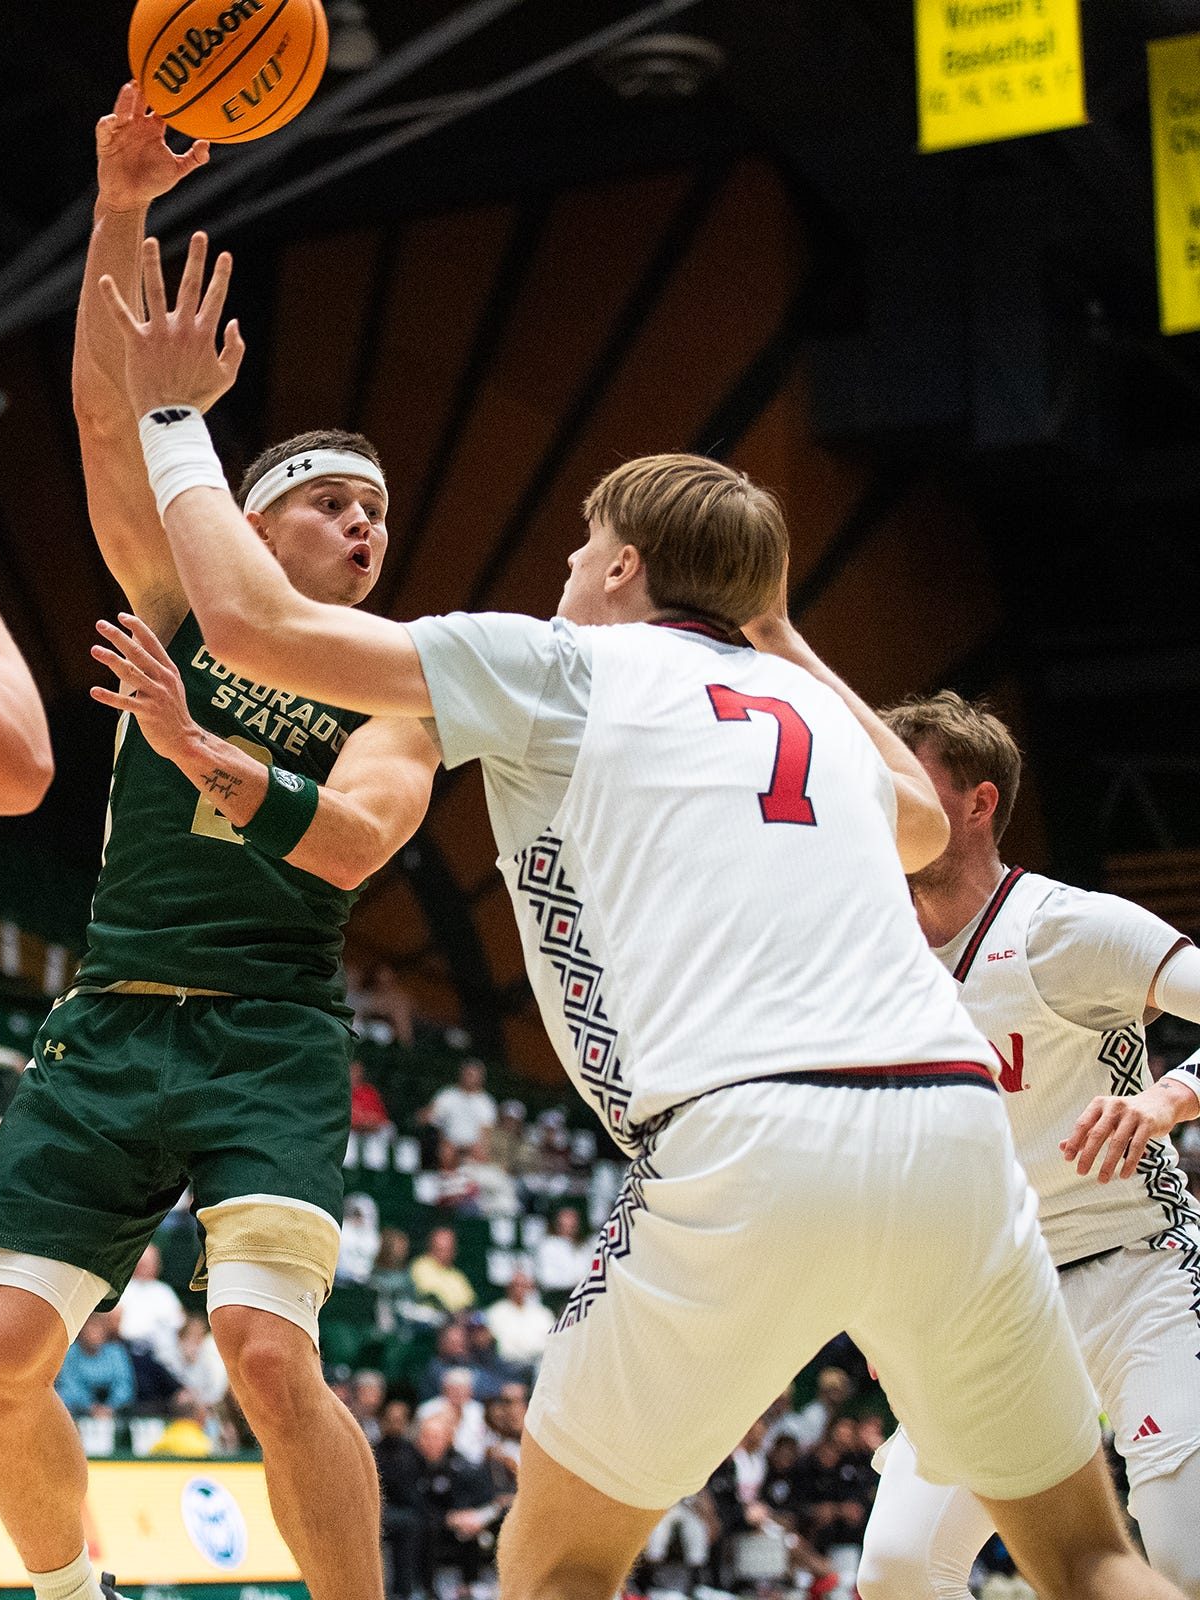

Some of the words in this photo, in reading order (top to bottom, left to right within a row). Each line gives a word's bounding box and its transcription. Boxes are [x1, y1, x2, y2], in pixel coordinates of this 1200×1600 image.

[154, 0, 264, 94] Wilson
[211, 685, 309, 756] STATE
[705, 684, 817, 827] 7
[987, 950, 1013, 962] SLC
